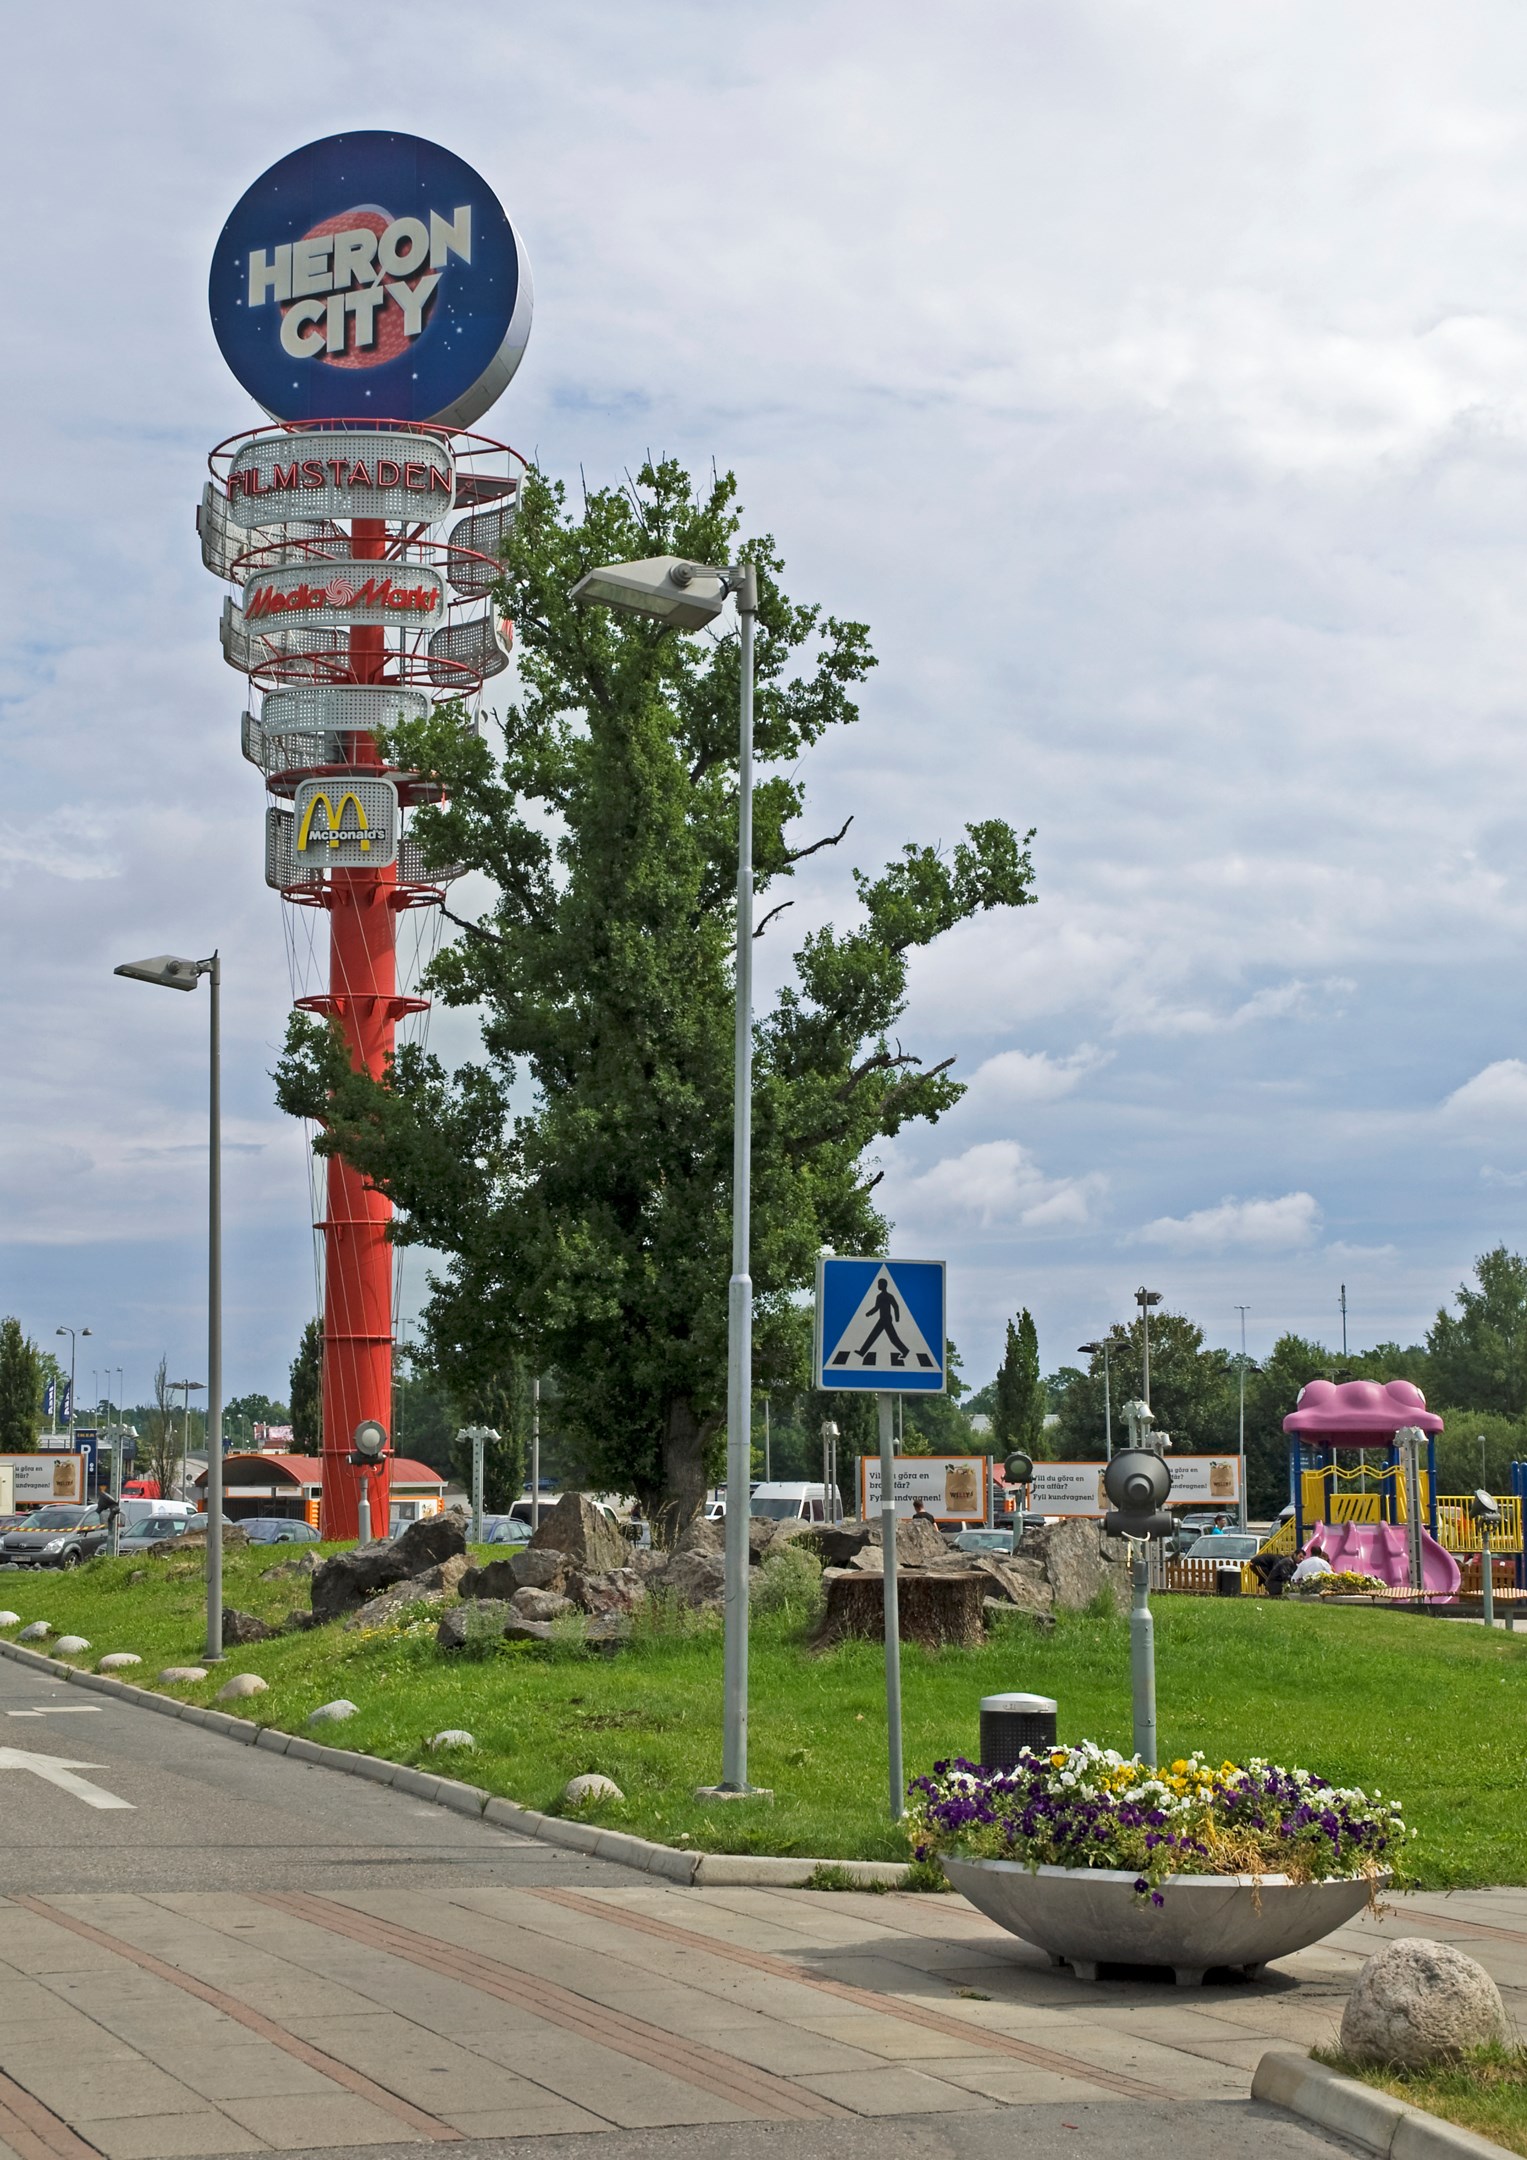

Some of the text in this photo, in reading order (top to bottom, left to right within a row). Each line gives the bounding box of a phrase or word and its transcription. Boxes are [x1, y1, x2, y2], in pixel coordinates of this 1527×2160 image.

[248, 204, 472, 308] HERON
[280, 272, 443, 359] CITY
[227, 459, 453, 501] FILMSTADEN
[244, 578, 439, 620] Media Markt
[308, 829, 386, 841] McDonald's
[81, 1444, 92, 1454] P
[898, 1472, 917, 1480] göra
[1057, 1475, 1074, 1483] göra
[869, 1494, 883, 1502] Fyl
[1048, 1494, 1095, 1502] kundvagnen!
